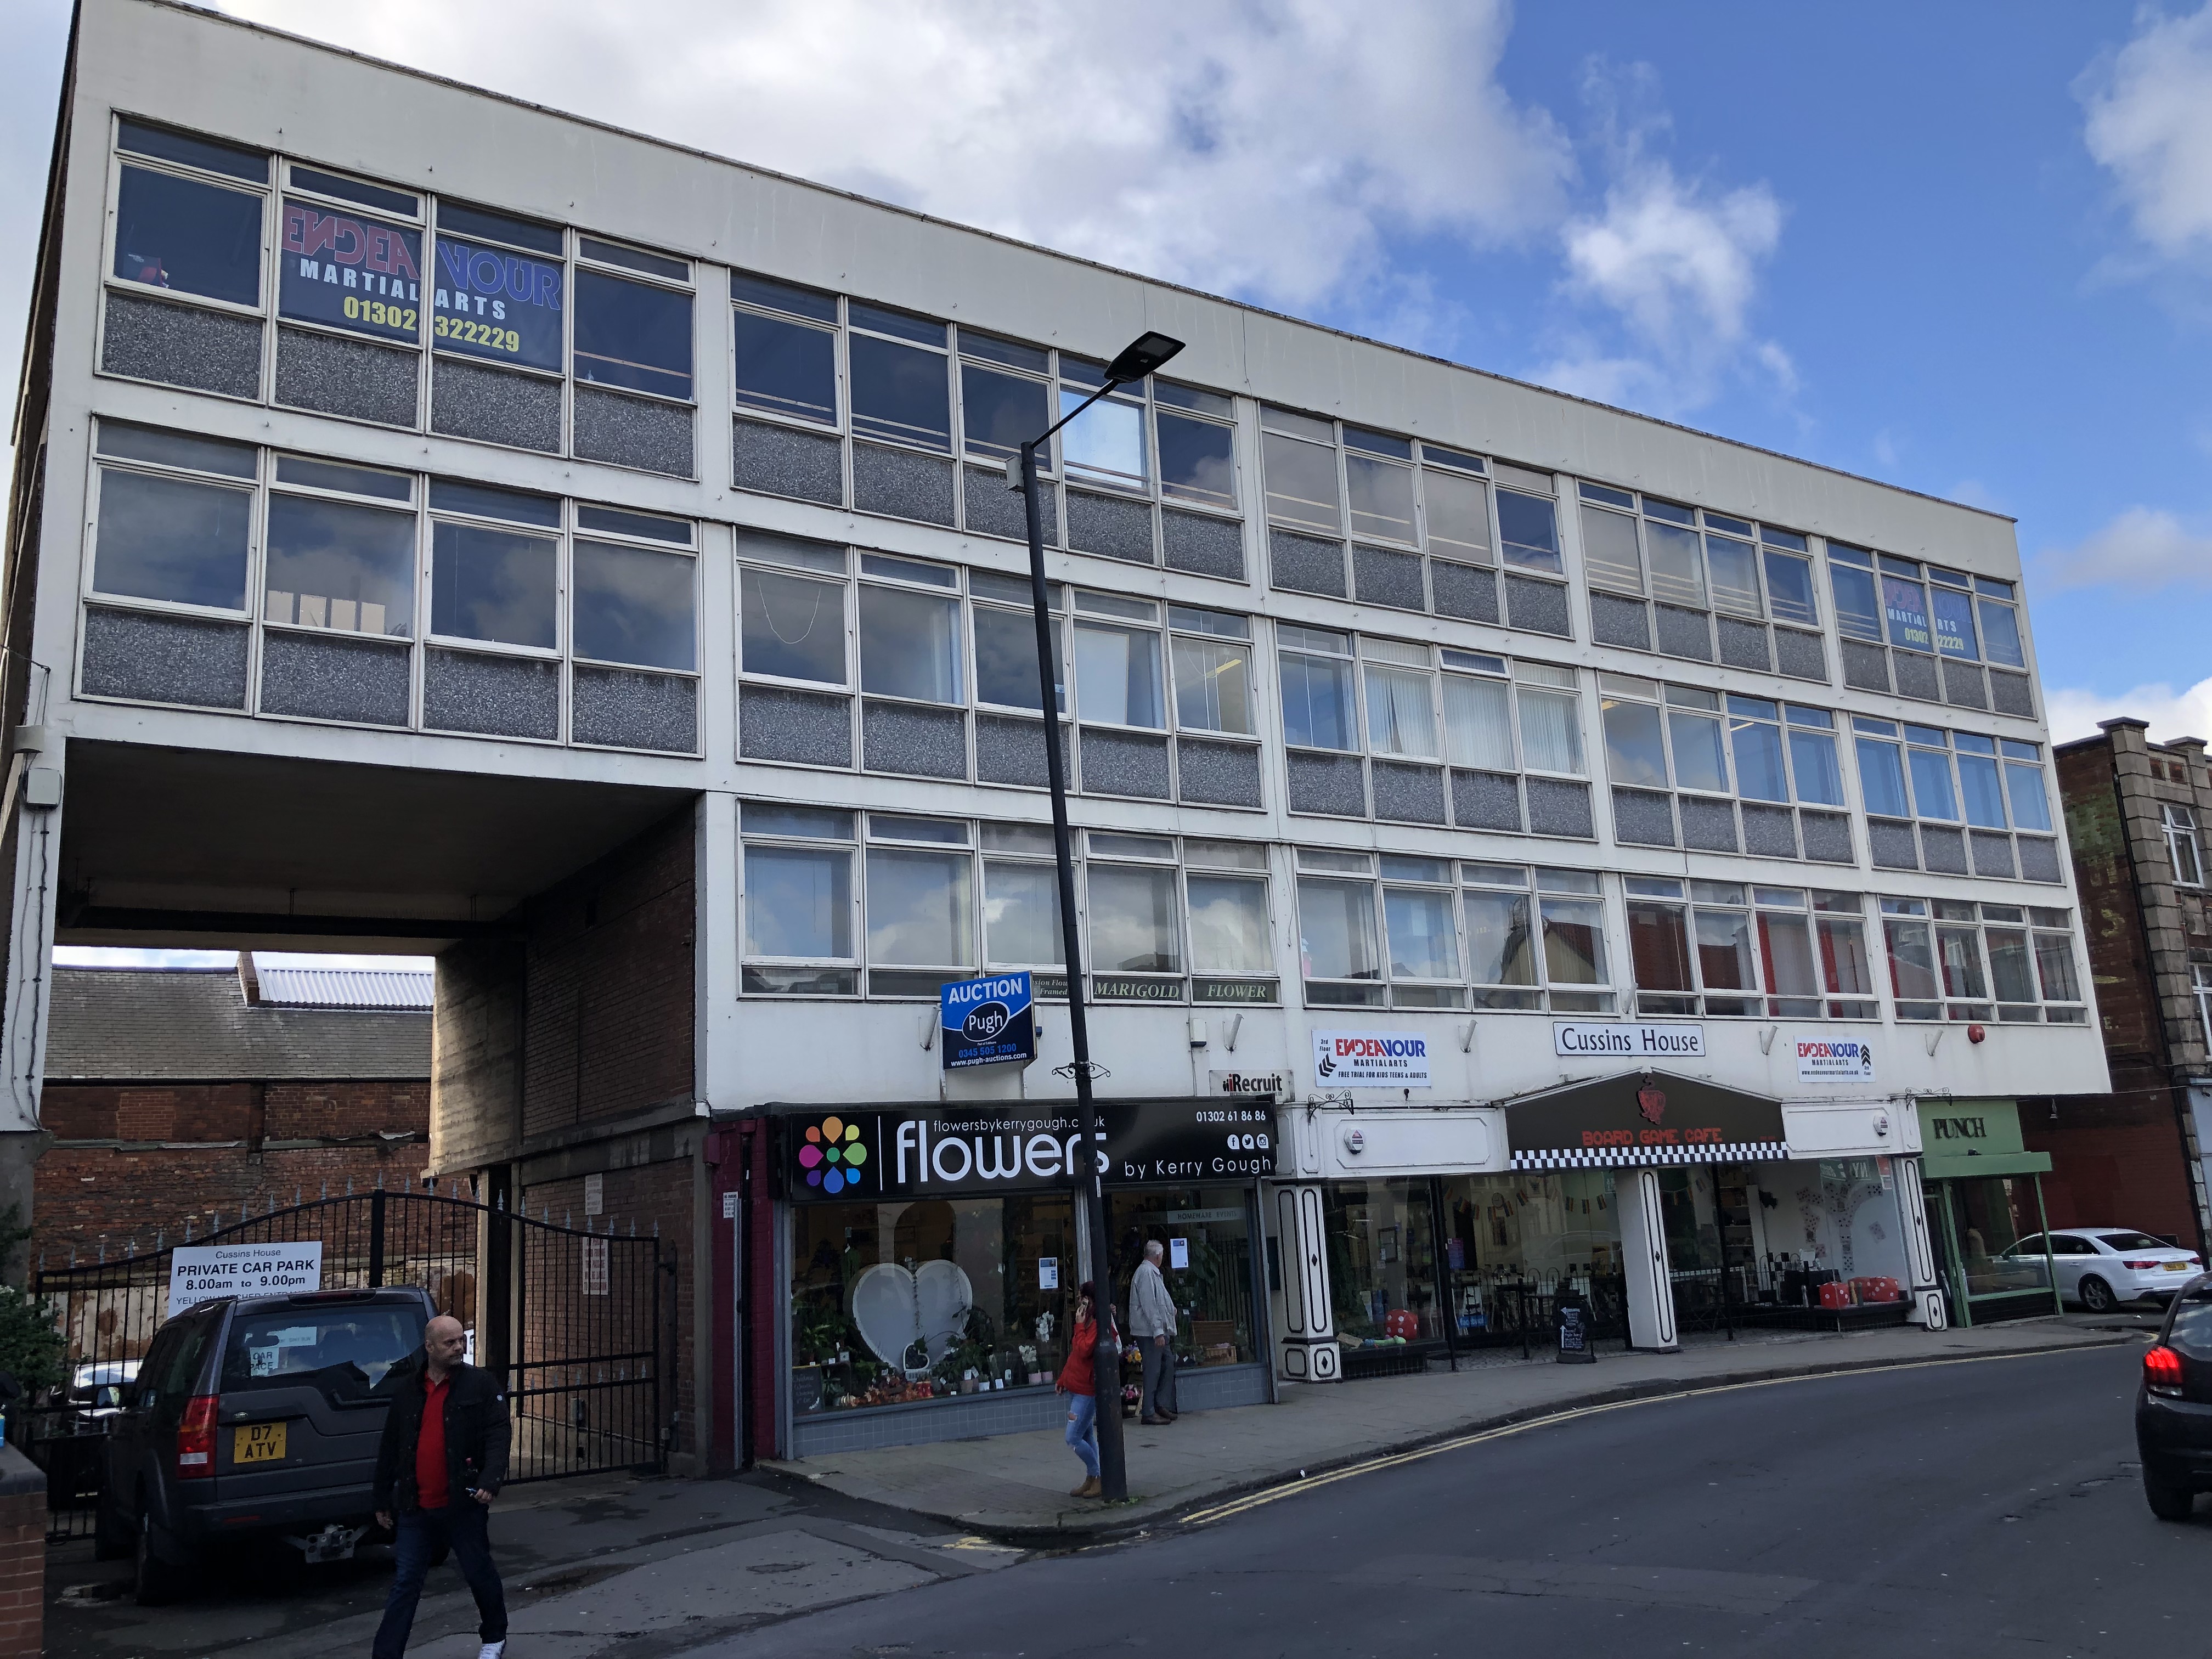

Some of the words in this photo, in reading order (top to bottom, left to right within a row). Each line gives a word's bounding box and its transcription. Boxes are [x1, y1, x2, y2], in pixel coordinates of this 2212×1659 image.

[300, 258, 419, 302] MARTIAL
[435, 288, 506, 320] ARTS
[344, 296, 416, 331] 01302
[435, 315, 519, 352] 322229
[1888, 608, 1927, 627] MARTIAL
[1938, 618, 1956, 632] RTS
[1938, 635, 1964, 650] 22229
[949, 978, 1022, 1004] AUCTION
[1094, 982, 1180, 998] MARIGOLD
[1207, 984, 1266, 998] FLOWER
[969, 1011, 1003, 1034] Pugh
[1335, 1038, 1426, 1057] ENDEAVOUR
[1562, 1028, 1631, 1051] Cussins
[1642, 1029, 1698, 1052] House
[958, 1048, 978, 1058] 0345
[980, 1046, 995, 1055] 505
[997, 1043, 1017, 1052] 1200
[1797, 1043, 1859, 1057] ENDEAVOUR
[951, 1052, 1027, 1066] www.pugh-auctions.com
[1228, 1073, 1283, 1092] iRecruit
[934, 1115, 1105, 1132] flowersbykerrygough.cuk
[1196, 1110, 1225, 1122] 01302
[1228, 1110, 1237, 1122] 61
[1241, 1110, 1252, 1121] 86
[1255, 1110, 1266, 1121] 86
[1582, 1129, 1633, 1146] BOARD
[1640, 1129, 1679, 1144] GAME
[1685, 1127, 1723, 1143] CAFE
[1932, 1118, 1987, 1139] PUNCH
[897, 1120, 1110, 1183] flowers
[1125, 1161, 1146, 1180] by
[1156, 1160, 1203, 1176] Kerry
[1212, 1156, 1271, 1173] Gough
[1178, 1211, 1211, 1220] HOMEWARE
[216, 1250, 250, 1259] Cussins
[177, 1263, 238, 1276] PRIVATE
[242, 1262, 272, 1273] CAR
[277, 1260, 314, 1271] PARK
[186, 1279, 232, 1290] 8.00am
[260, 1275, 305, 1286] 9.00pm
[251, 1425, 272, 1441] D7
[245, 1442, 276, 1458] ATV
